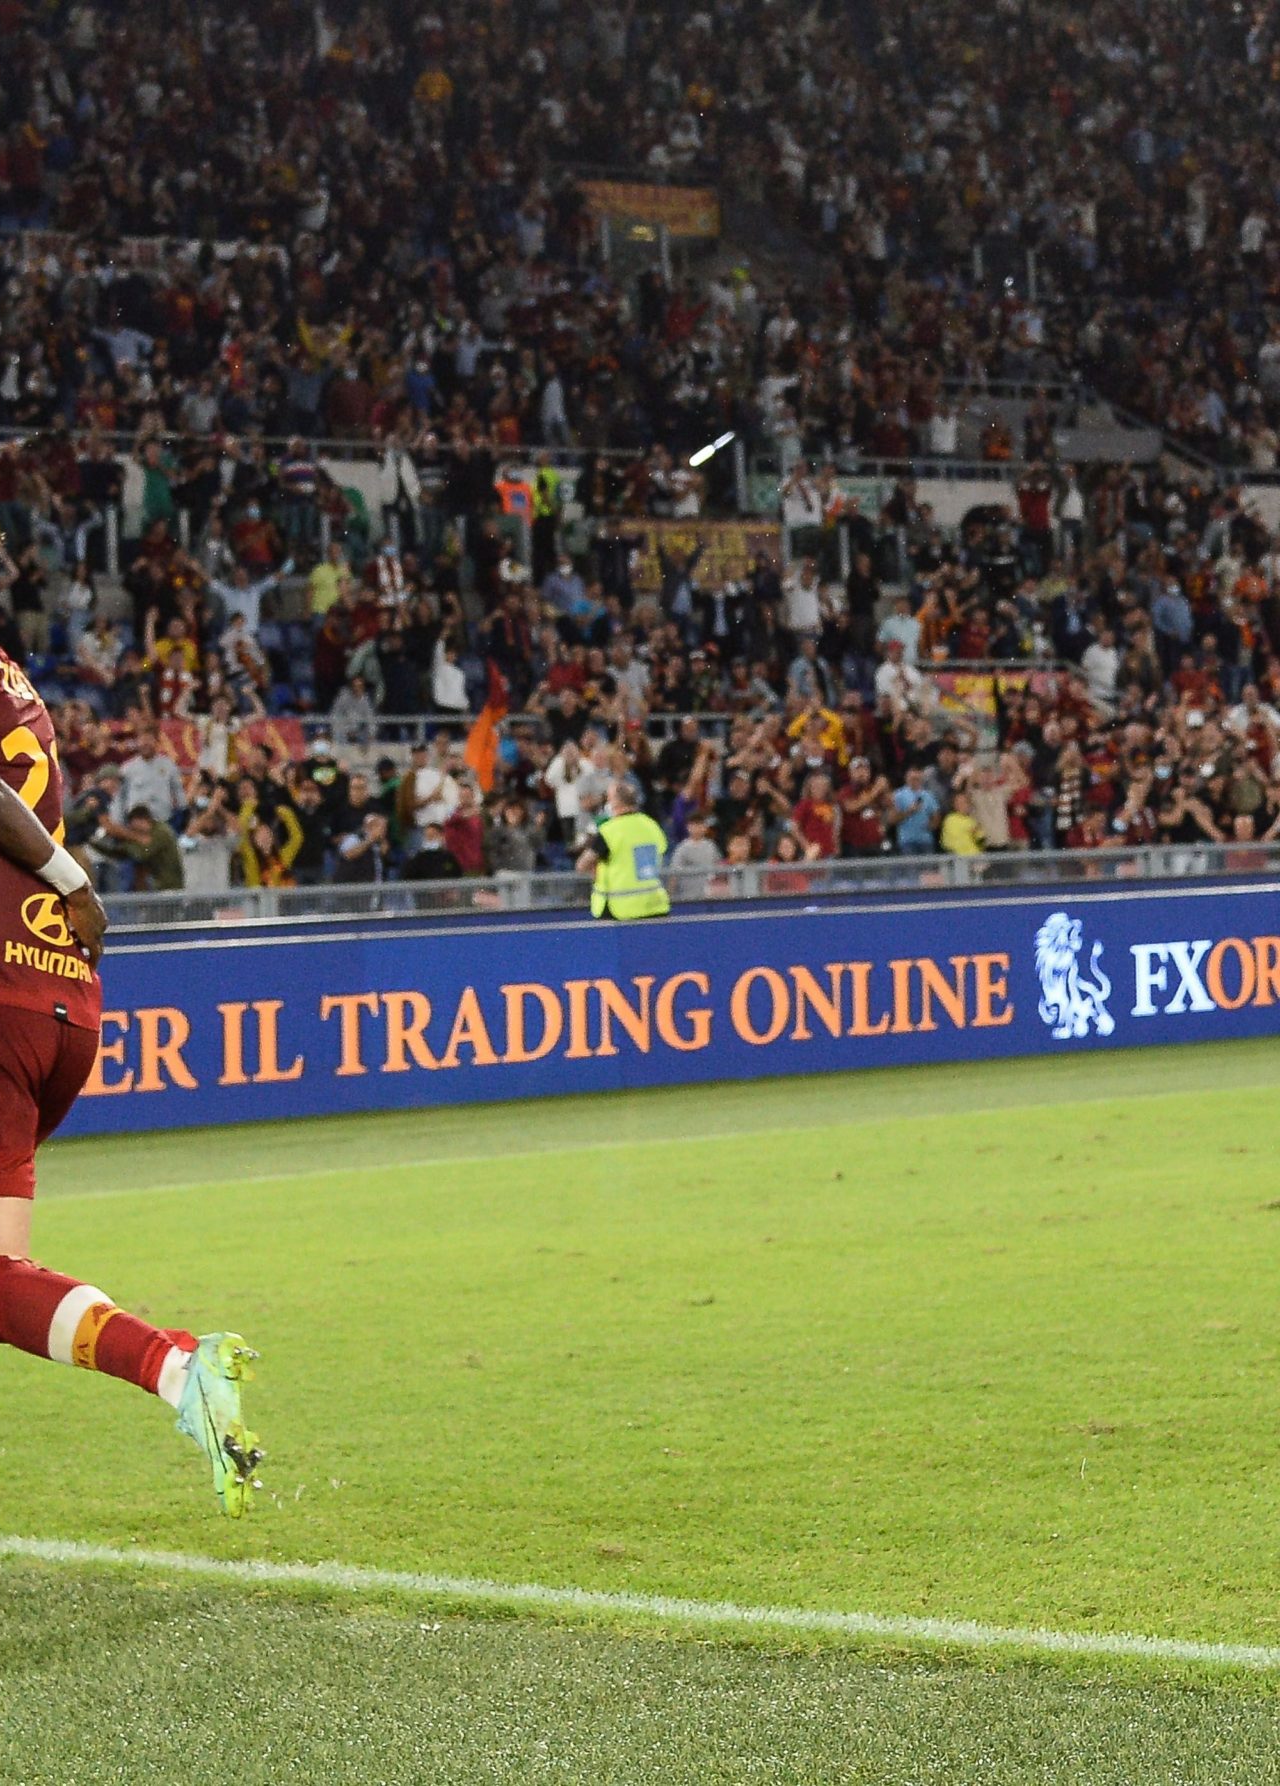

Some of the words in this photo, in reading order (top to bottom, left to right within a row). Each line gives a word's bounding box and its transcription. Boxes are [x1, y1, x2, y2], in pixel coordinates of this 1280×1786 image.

[4, 940, 94, 984] HYUNDAI
[80, 1007, 198, 1097] ER
[217, 1000, 305, 1086] IL
[320, 970, 713, 1076] TRADING
[730, 953, 1015, 1046] ONLINE
